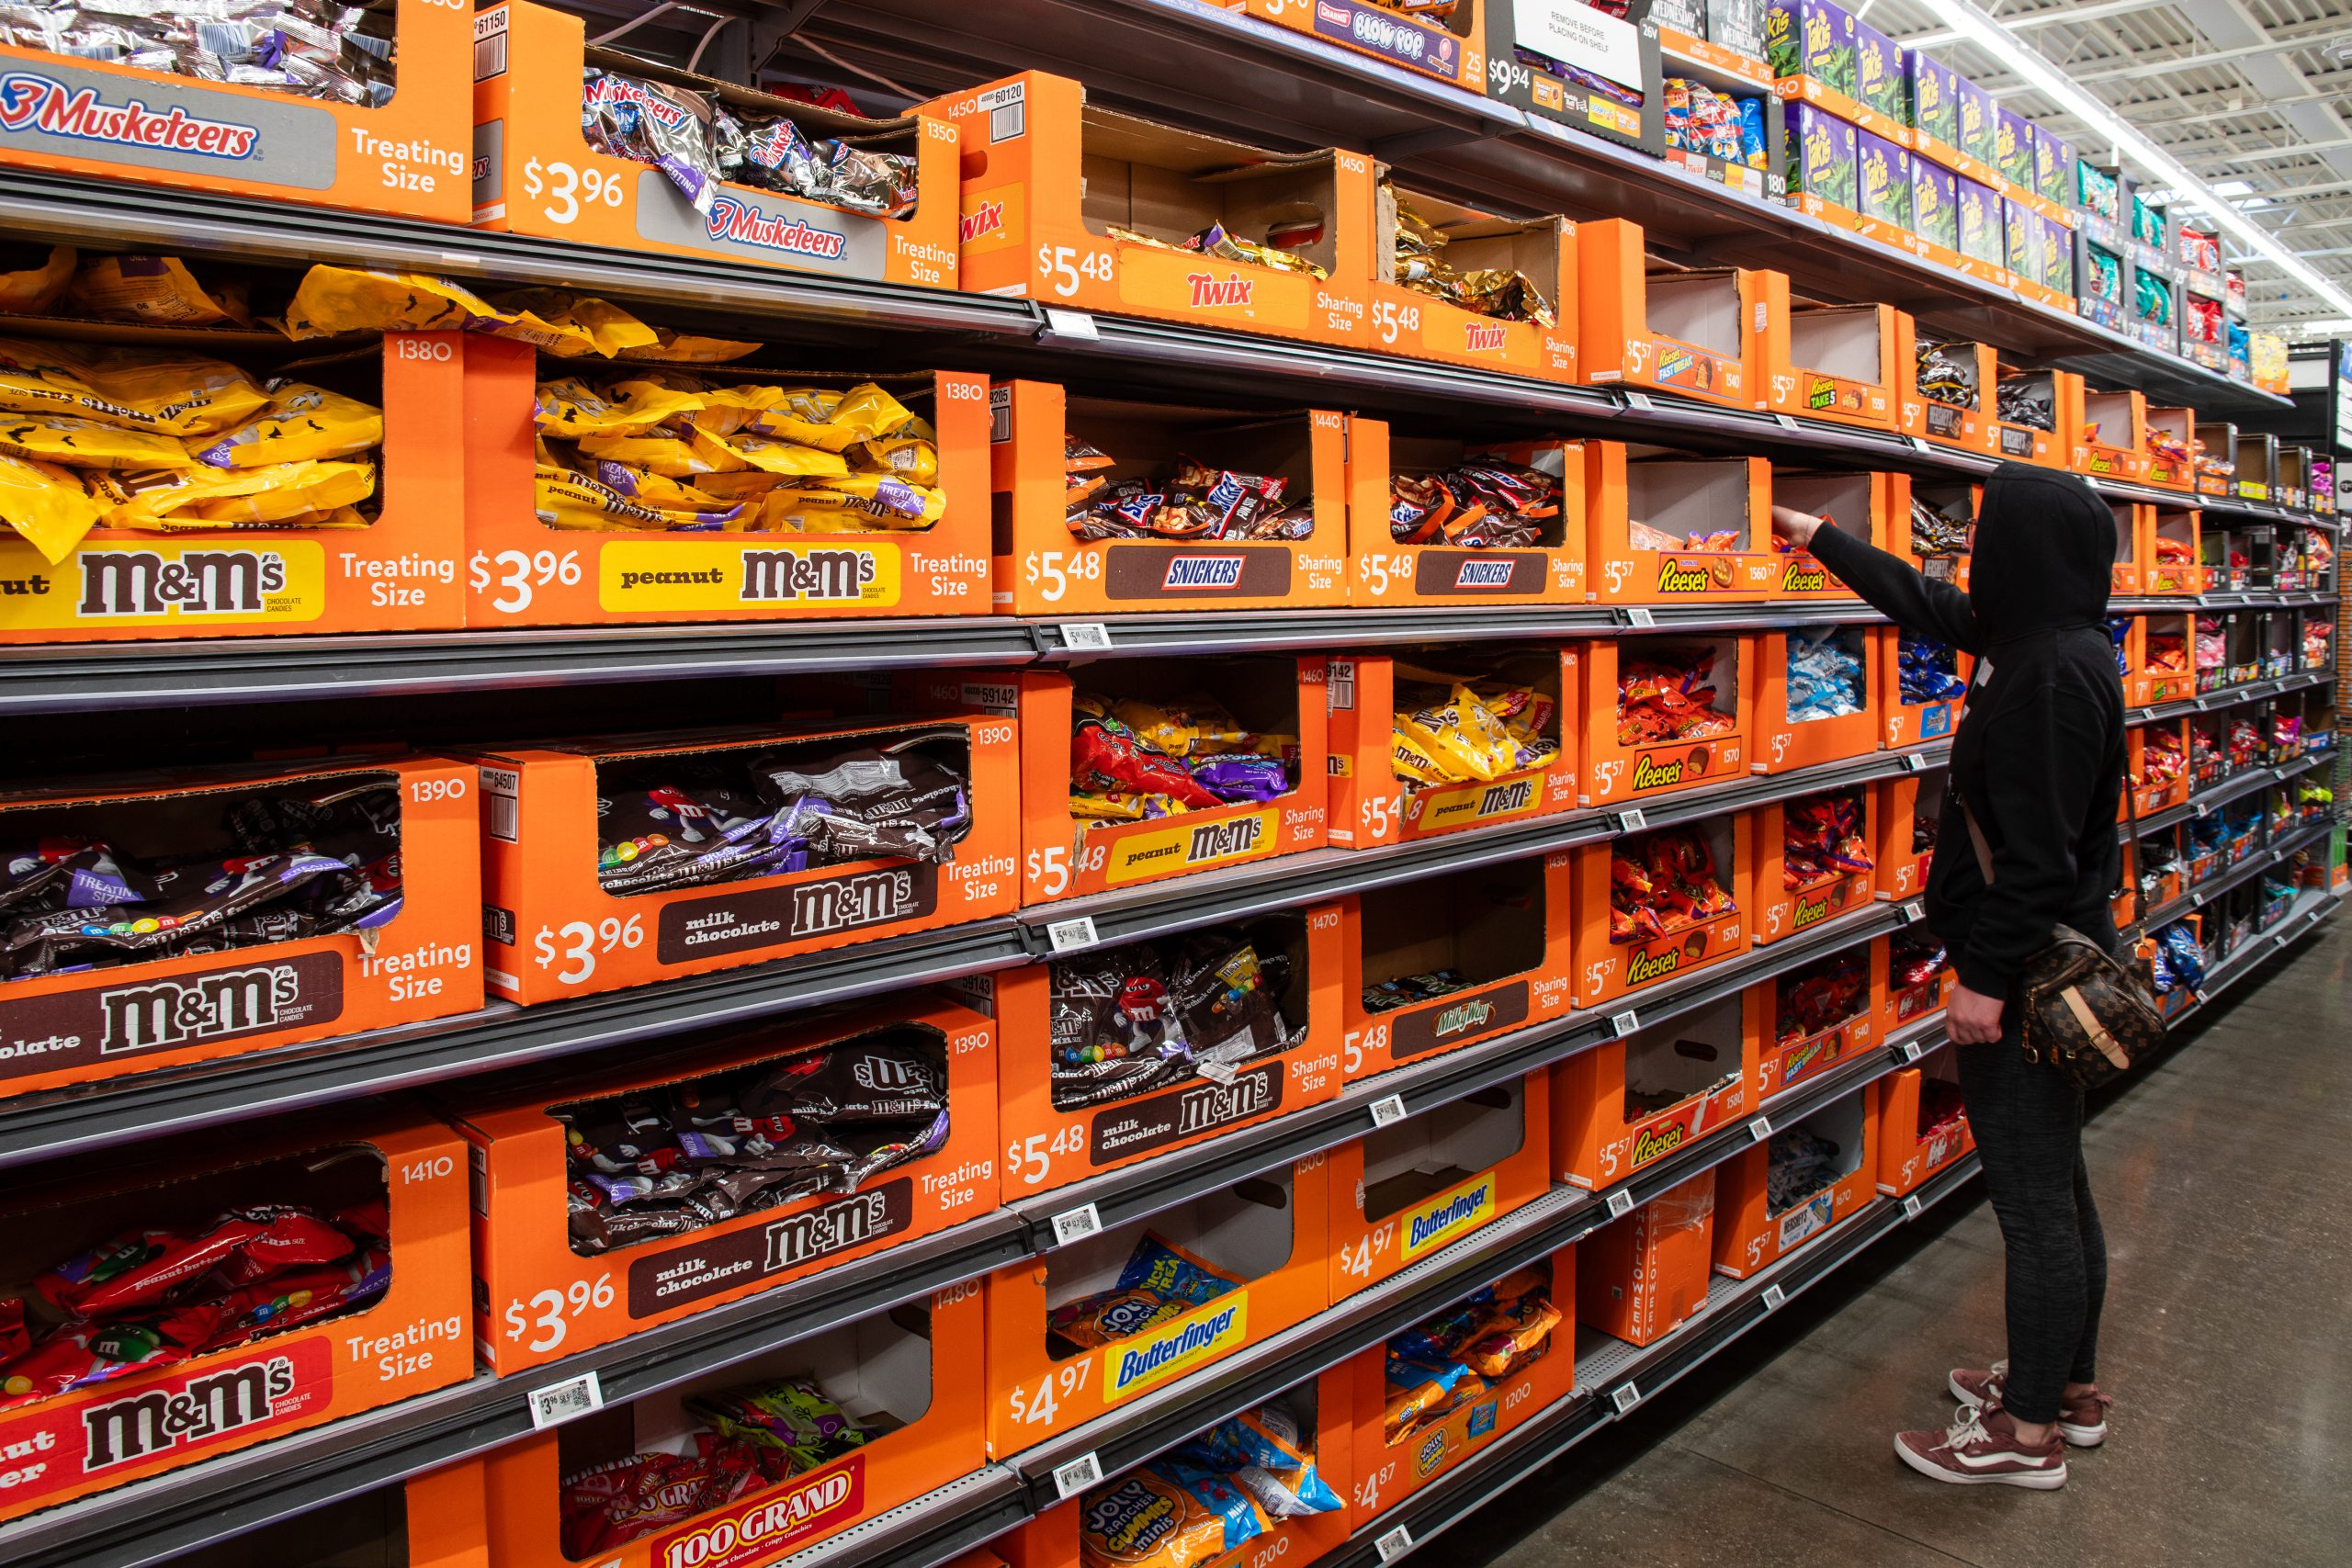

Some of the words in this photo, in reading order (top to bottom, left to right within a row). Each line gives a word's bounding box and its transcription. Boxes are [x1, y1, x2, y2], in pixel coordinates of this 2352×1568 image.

[1354, 12, 1395, 49] BLOW
[1551, 11, 1578, 31] REMOVE
[1579, 23, 1605, 40] BEFORE
[1549, 25, 1577, 42] PLACING
[1578, 34, 1589, 47] ON
[1589, 39, 1610, 53] SHELF
[1466, 51, 1482, 73] 25
[946, 98, 977, 120] 1450
[40, 97, 254, 158] Musketeers
[926, 121, 957, 144] 1350
[351, 128, 465, 176] Treating
[1340, 154, 1365, 175] 1450
[381, 162, 436, 194] Size
[1768, 174, 1785, 194] 180
[708, 202, 734, 235] 3
[731, 207, 843, 259] Musketeers
[894, 233, 956, 272] Treating
[910, 260, 941, 286] Size
[1186, 272, 1255, 309] Twix
[1317, 290, 1363, 320] Sharing
[1327, 311, 1353, 333] Size
[1464, 322, 1507, 352] Twix
[1544, 336, 1576, 358] Sharing
[396, 339, 453, 363] 1380
[1551, 354, 1568, 370] Size
[944, 381, 984, 401] 1380
[1314, 413, 1341, 430] 1440
[338, 552, 456, 584] Treating
[910, 552, 988, 579] Treating
[1167, 558, 1243, 587] SNICKERS
[1297, 553, 1343, 575] Sharing
[1459, 562, 1514, 584] SNICKERS
[1552, 558, 1584, 576] Sharing
[1749, 566, 1768, 581] 1560
[620, 566, 723, 591] peanut
[930, 576, 968, 597] Size
[1308, 572, 1332, 590] Size
[1558, 574, 1576, 589] Size
[266, 597, 302, 606] CHOCOLATE
[370, 581, 426, 608] Size
[266, 604, 293, 614] CANDIES
[1301, 669, 1324, 683] 1460
[978, 726, 1012, 746] 1390
[1723, 747, 1740, 764] 1570
[411, 778, 467, 803] 1390
[1547, 770, 1577, 789] Sharing
[1552, 787, 1569, 802] Size
[1285, 804, 1325, 828] Sharing
[1434, 798, 1476, 818] peanut
[1292, 825, 1316, 842] Size
[1125, 840, 1182, 867] peanut
[1548, 855, 1568, 870] 1430
[945, 852, 1015, 884] Treating
[964, 877, 998, 902] Size
[684, 911, 735, 932] milk
[684, 917, 781, 948] chocolate
[1312, 913, 1339, 931] 1470
[1722, 924, 1740, 942] 1570
[357, 942, 472, 979] Treating
[389, 974, 444, 1002] Size
[1532, 976, 1568, 997] Sharing
[279, 1003, 313, 1018] CHOCOLATE
[1541, 994, 1560, 1010] Size
[279, 1012, 304, 1024] CANDIES
[953, 1031, 990, 1055] 1390
[1853, 1022, 1870, 1040] 1540
[1291, 1054, 1338, 1080] Sharing
[1301, 1073, 1327, 1093] Size
[1102, 1118, 1139, 1137] milk
[1102, 1121, 1171, 1151] chocolate
[401, 1156, 454, 1185] 1410
[1296, 1152, 1326, 1176] 1500
[921, 1159, 994, 1197] Treating
[939, 1186, 976, 1213] Size
[1408, 1182, 1489, 1250] Butterfinger
[133, 1267, 183, 1292] peanut
[655, 1257, 707, 1284] milk
[655, 1258, 753, 1299] chocolate
[935, 1277, 981, 1311] 1480
[345, 1313, 462, 1363] Treating
[1115, 1305, 1238, 1391] Butterfinger
[378, 1348, 435, 1382] Size
[274, 1392, 311, 1410] CHOCOLATE
[274, 1402, 302, 1416] CANDIES
[1505, 1382, 1532, 1411] 1200
[741, 1474, 849, 1542] GRAND
[1091, 1479, 1147, 1530] JOLLY
[1104, 1493, 1157, 1538] RANCHER
[1107, 1495, 1175, 1552] GUMMIES
[1134, 1517, 1174, 1552] minis
[729, 1544, 761, 1562] Chocolate
[784, 1522, 813, 1540] Crunchies
